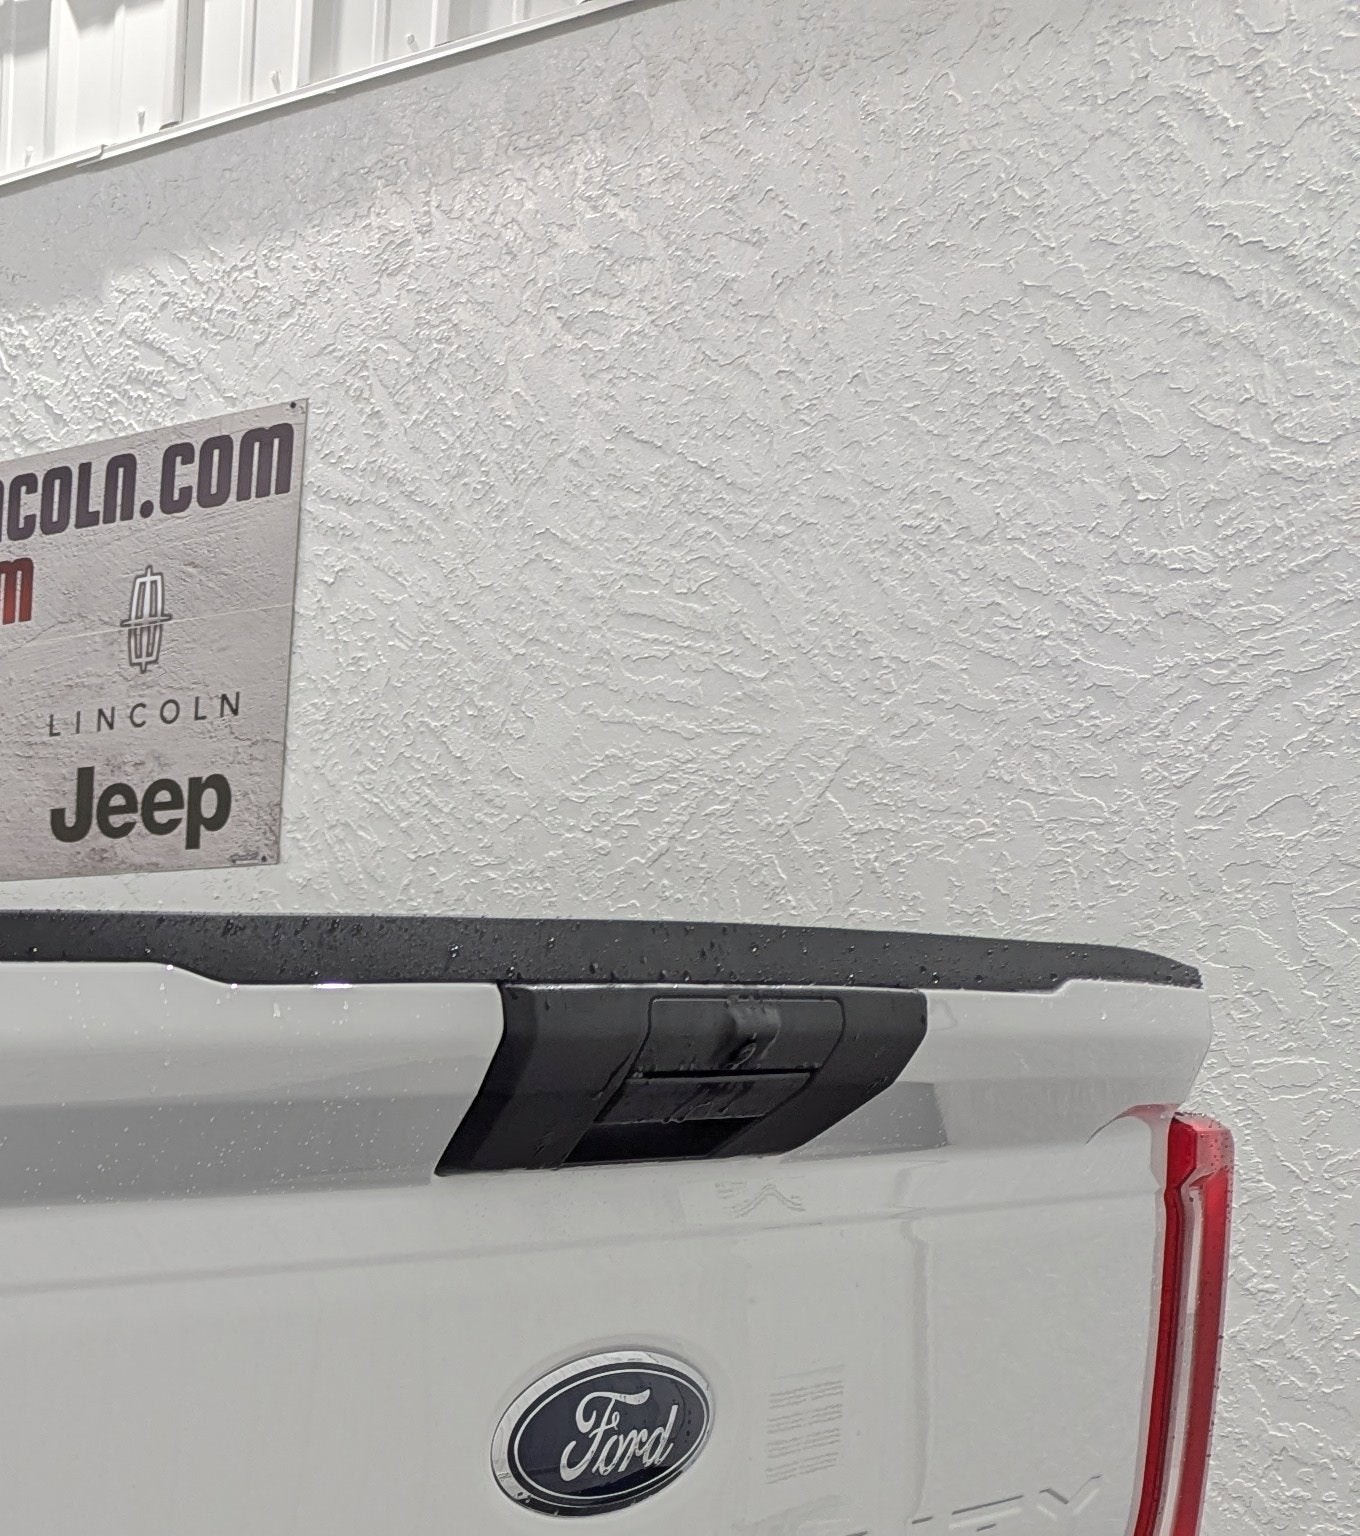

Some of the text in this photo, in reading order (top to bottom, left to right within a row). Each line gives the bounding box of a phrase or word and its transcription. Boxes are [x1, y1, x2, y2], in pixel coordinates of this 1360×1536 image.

[47, 690, 241, 737] LINCOLN
[49, 765, 232, 850] Jeep
[559, 1388, 679, 1483] Ford
